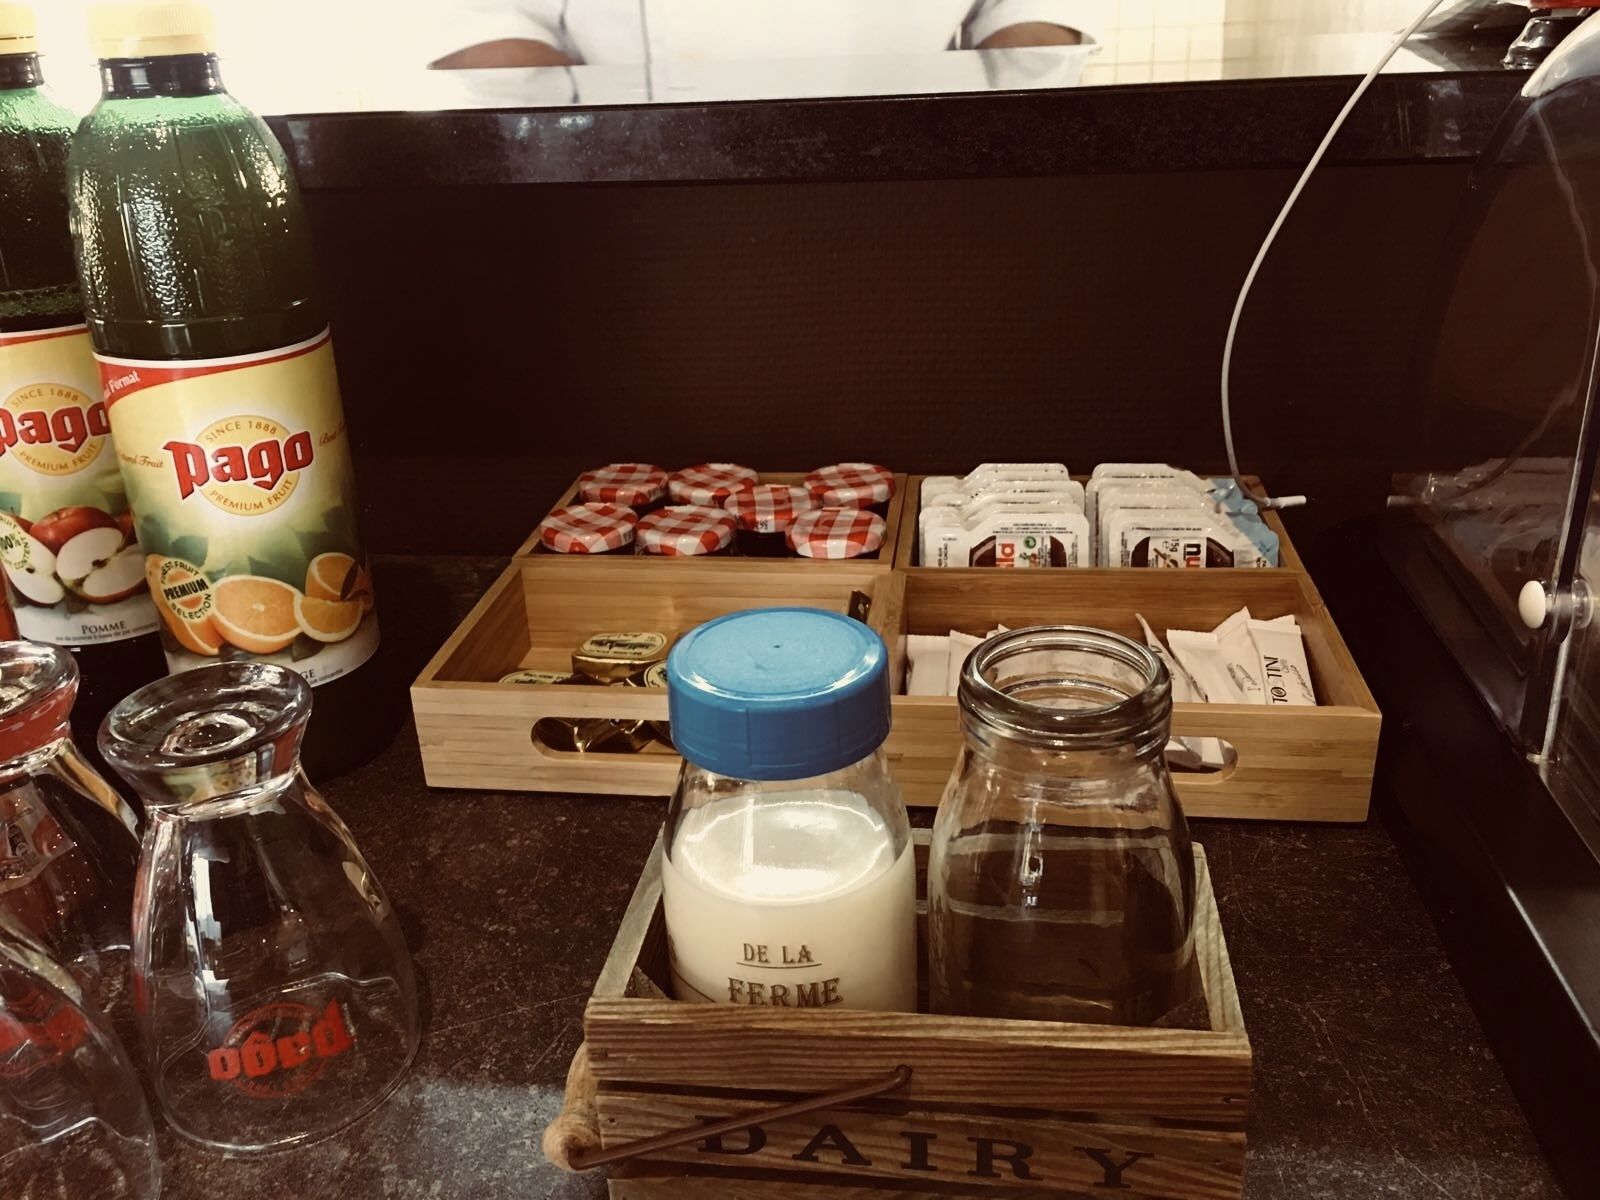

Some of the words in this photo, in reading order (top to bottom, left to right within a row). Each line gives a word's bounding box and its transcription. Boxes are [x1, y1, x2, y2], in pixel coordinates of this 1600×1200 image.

[107, 370, 141, 393] Format
[10, 388, 44, 408] SINCE
[50, 388, 80, 402] 1888
[206, 420, 242, 444] SINCE
[248, 420, 278, 436] 1888
[19, 450, 70, 472] PREMIUM
[162, 430, 314, 500] pago
[210, 489, 265, 511] PREMIUM
[267, 478, 295, 506] FRUIT
[163, 577, 209, 601] PREMIUM
[81, 620, 128, 635] POMME
[743, 942, 770, 963] DE
[781, 944, 815, 964] LA
[727, 976, 845, 1008] FERME
[693, 1113, 1156, 1190] DAIRY
